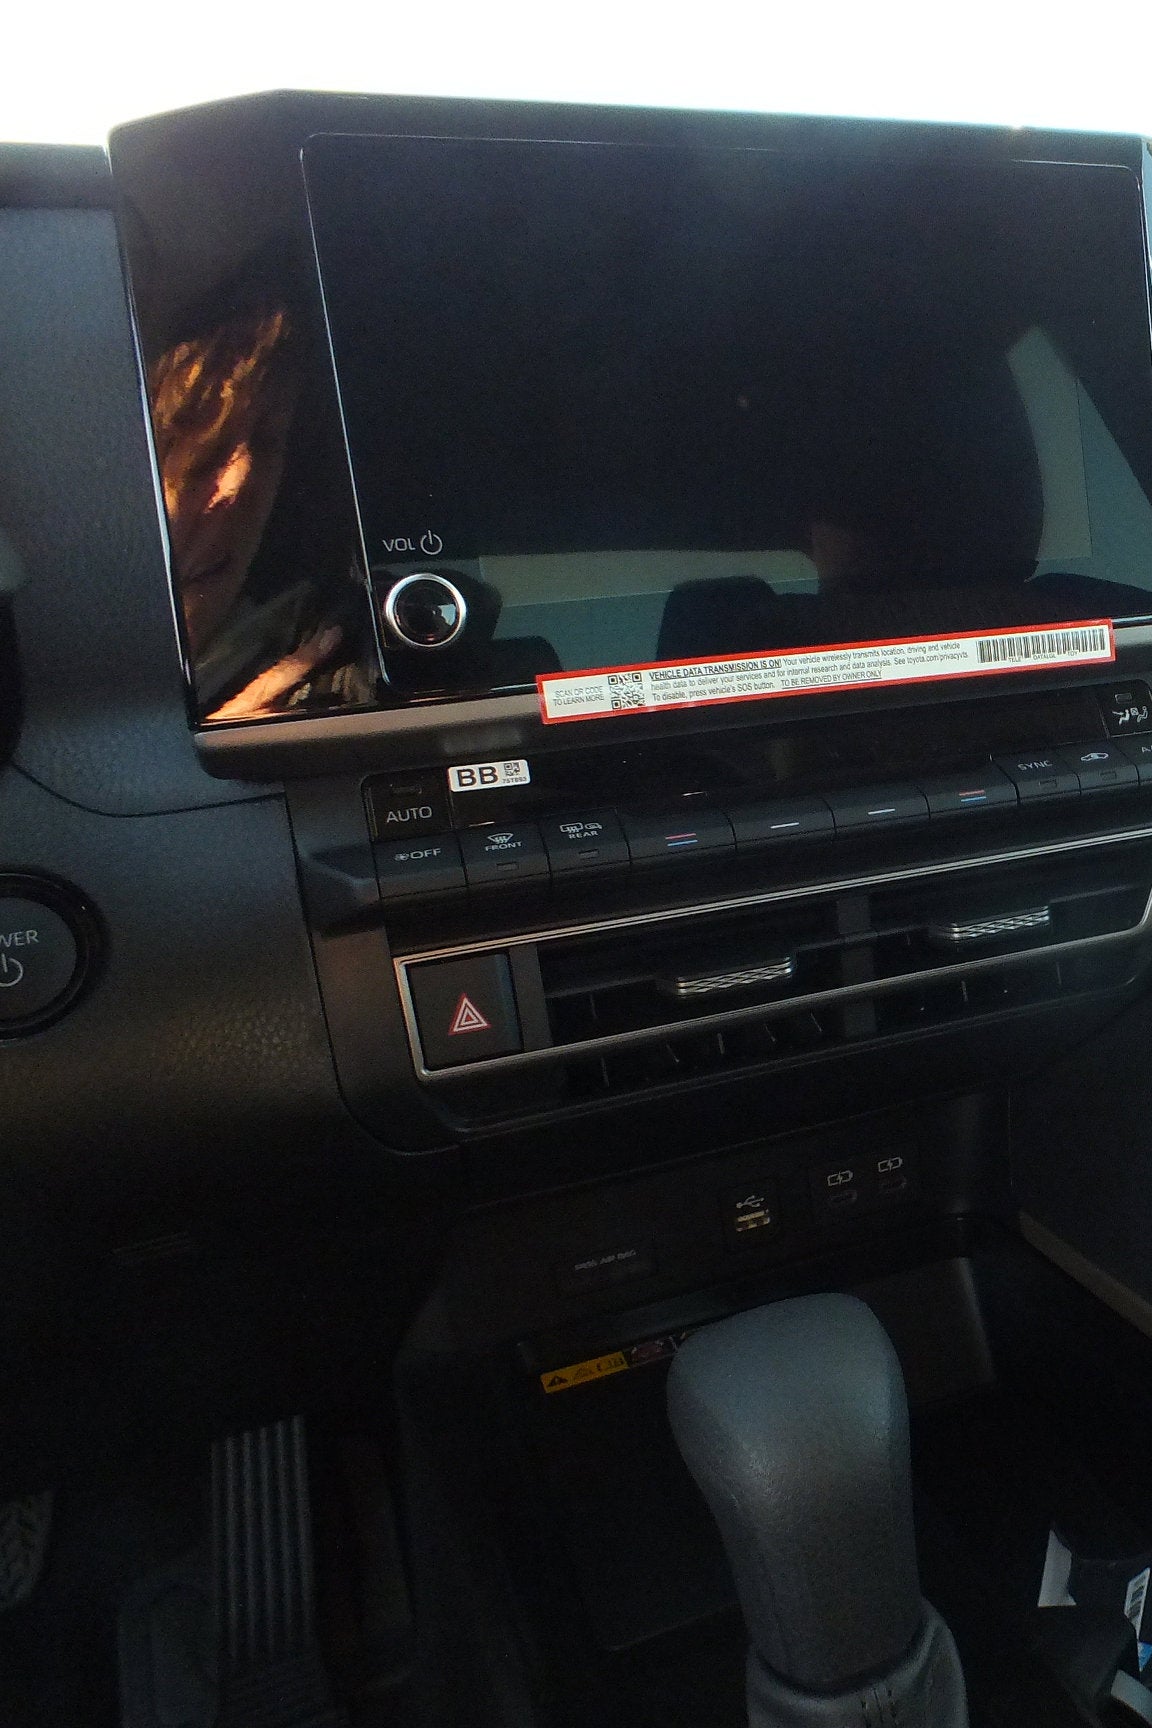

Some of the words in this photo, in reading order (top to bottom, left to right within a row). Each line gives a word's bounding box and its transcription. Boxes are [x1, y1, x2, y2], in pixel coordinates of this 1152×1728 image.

[382, 537, 416, 552] VOL
[783, 657, 798, 666] Your
[799, 654, 821, 664] vehicle
[822, 652, 852, 662] wirelessly
[852, 650, 881, 659] transmits
[907, 644, 927, 654] driving
[928, 643, 940, 651] and
[941, 641, 961, 650] vehicle
[649, 669, 681, 681] VEHICLE
[683, 667, 703, 678] DATA
[703, 661, 759, 675] TRANSMISSION
[760, 660, 768, 670] IS
[672, 680, 688, 689] data
[698, 676, 719, 686] deliver
[720, 675, 734, 684] your
[736, 671, 762, 681] services
[763, 670, 776, 679] and
[776, 668, 785, 678] for
[811, 664, 838, 674] research
[839, 662, 851, 671] and
[851, 660, 866, 670] data
[894, 657, 906, 665] See
[554, 689, 573, 699] SCAN
[585, 685, 603, 695] CODE
[652, 693, 660, 702] To
[690, 689, 707, 699] press
[738, 682, 753, 692] SOS
[781, 678, 791, 687] TO
[791, 677, 801, 687] BE
[801, 675, 832, 686] REMOVED
[833, 673, 842, 682] BY
[842, 671, 866, 681] OWNER
[866, 669, 882, 679] ONLY
[553, 698, 563, 707] TO
[563, 695, 585, 705] LEARN
[585, 693, 604, 703] MORE
[1017, 760, 1053, 771] SYNC
[457, 766, 499, 788] BB
[386, 806, 433, 823] AUTO
[568, 830, 600, 840] REAR
[410, 848, 442, 859] OFF
[485, 841, 522, 851] FRONT
